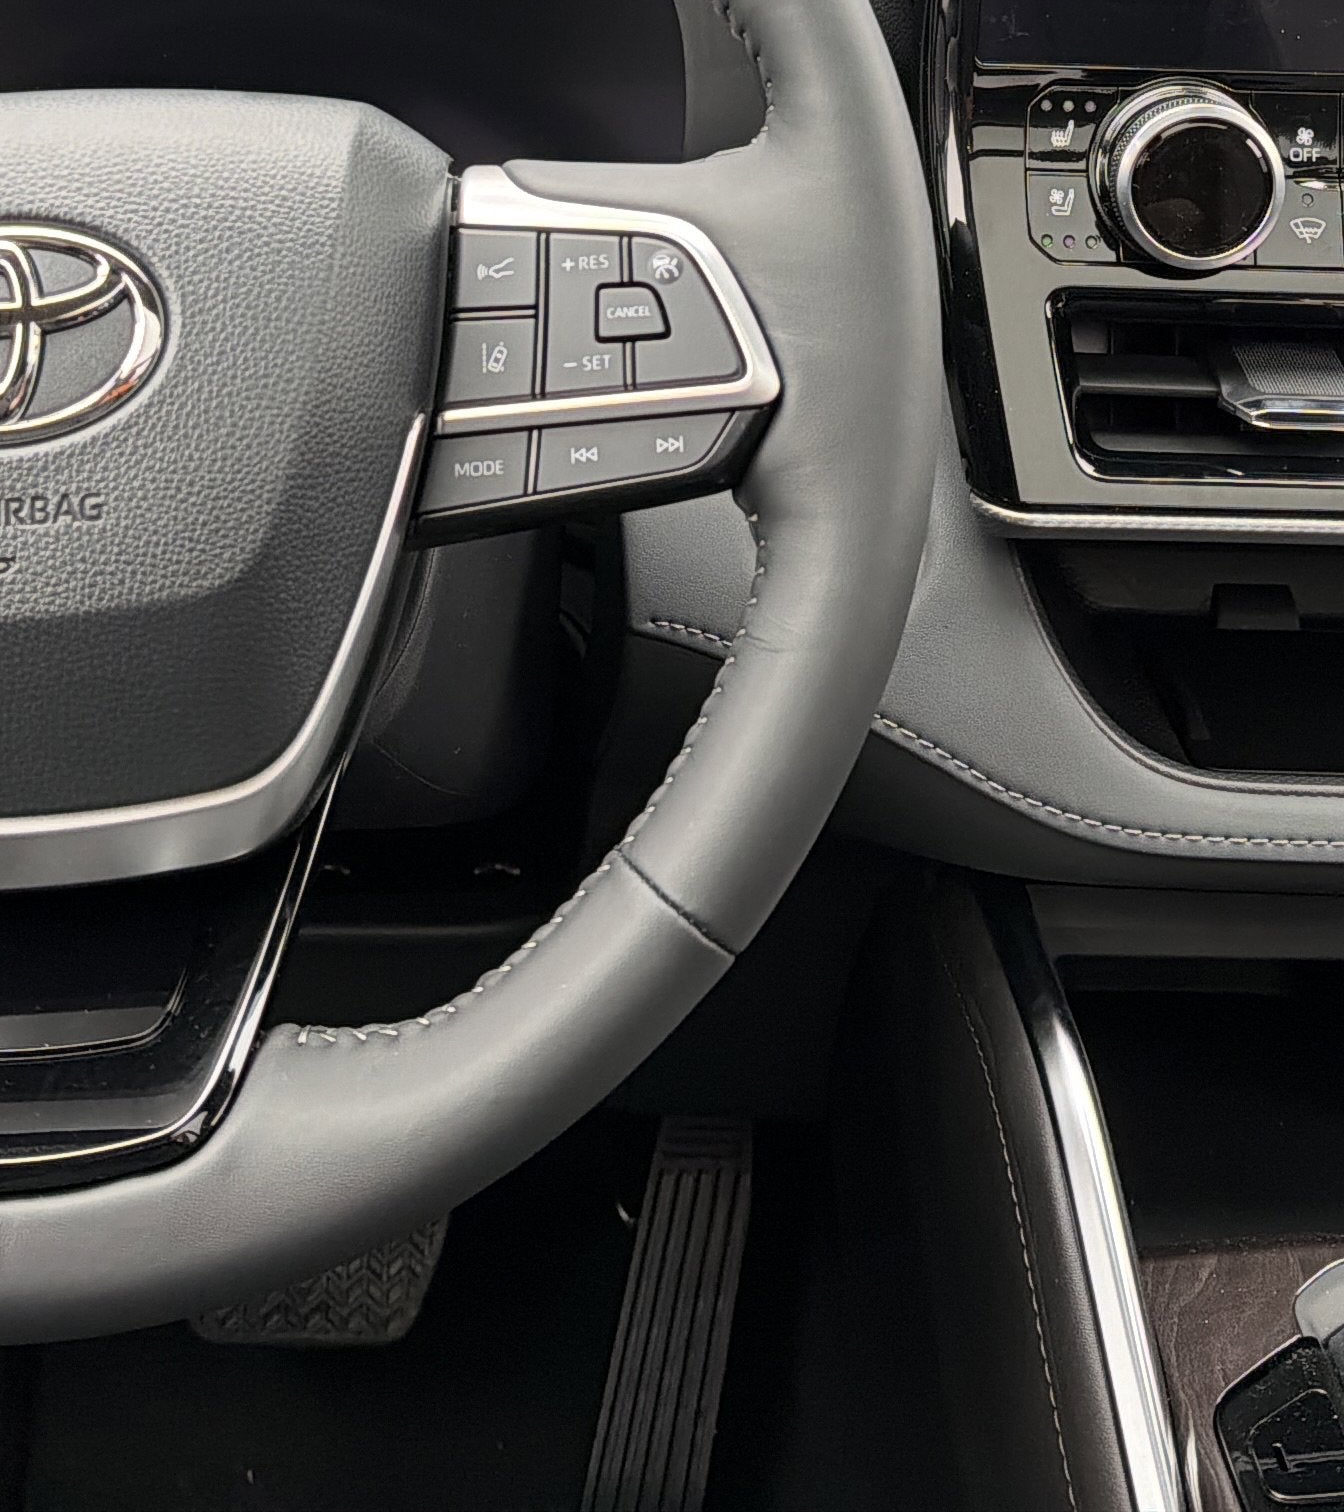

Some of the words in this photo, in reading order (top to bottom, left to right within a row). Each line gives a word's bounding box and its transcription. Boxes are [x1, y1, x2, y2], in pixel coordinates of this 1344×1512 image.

[1289, 147, 1321, 163] OFF
[606, 304, 650, 319] CANCEL
[455, 459, 504, 477] MODE
